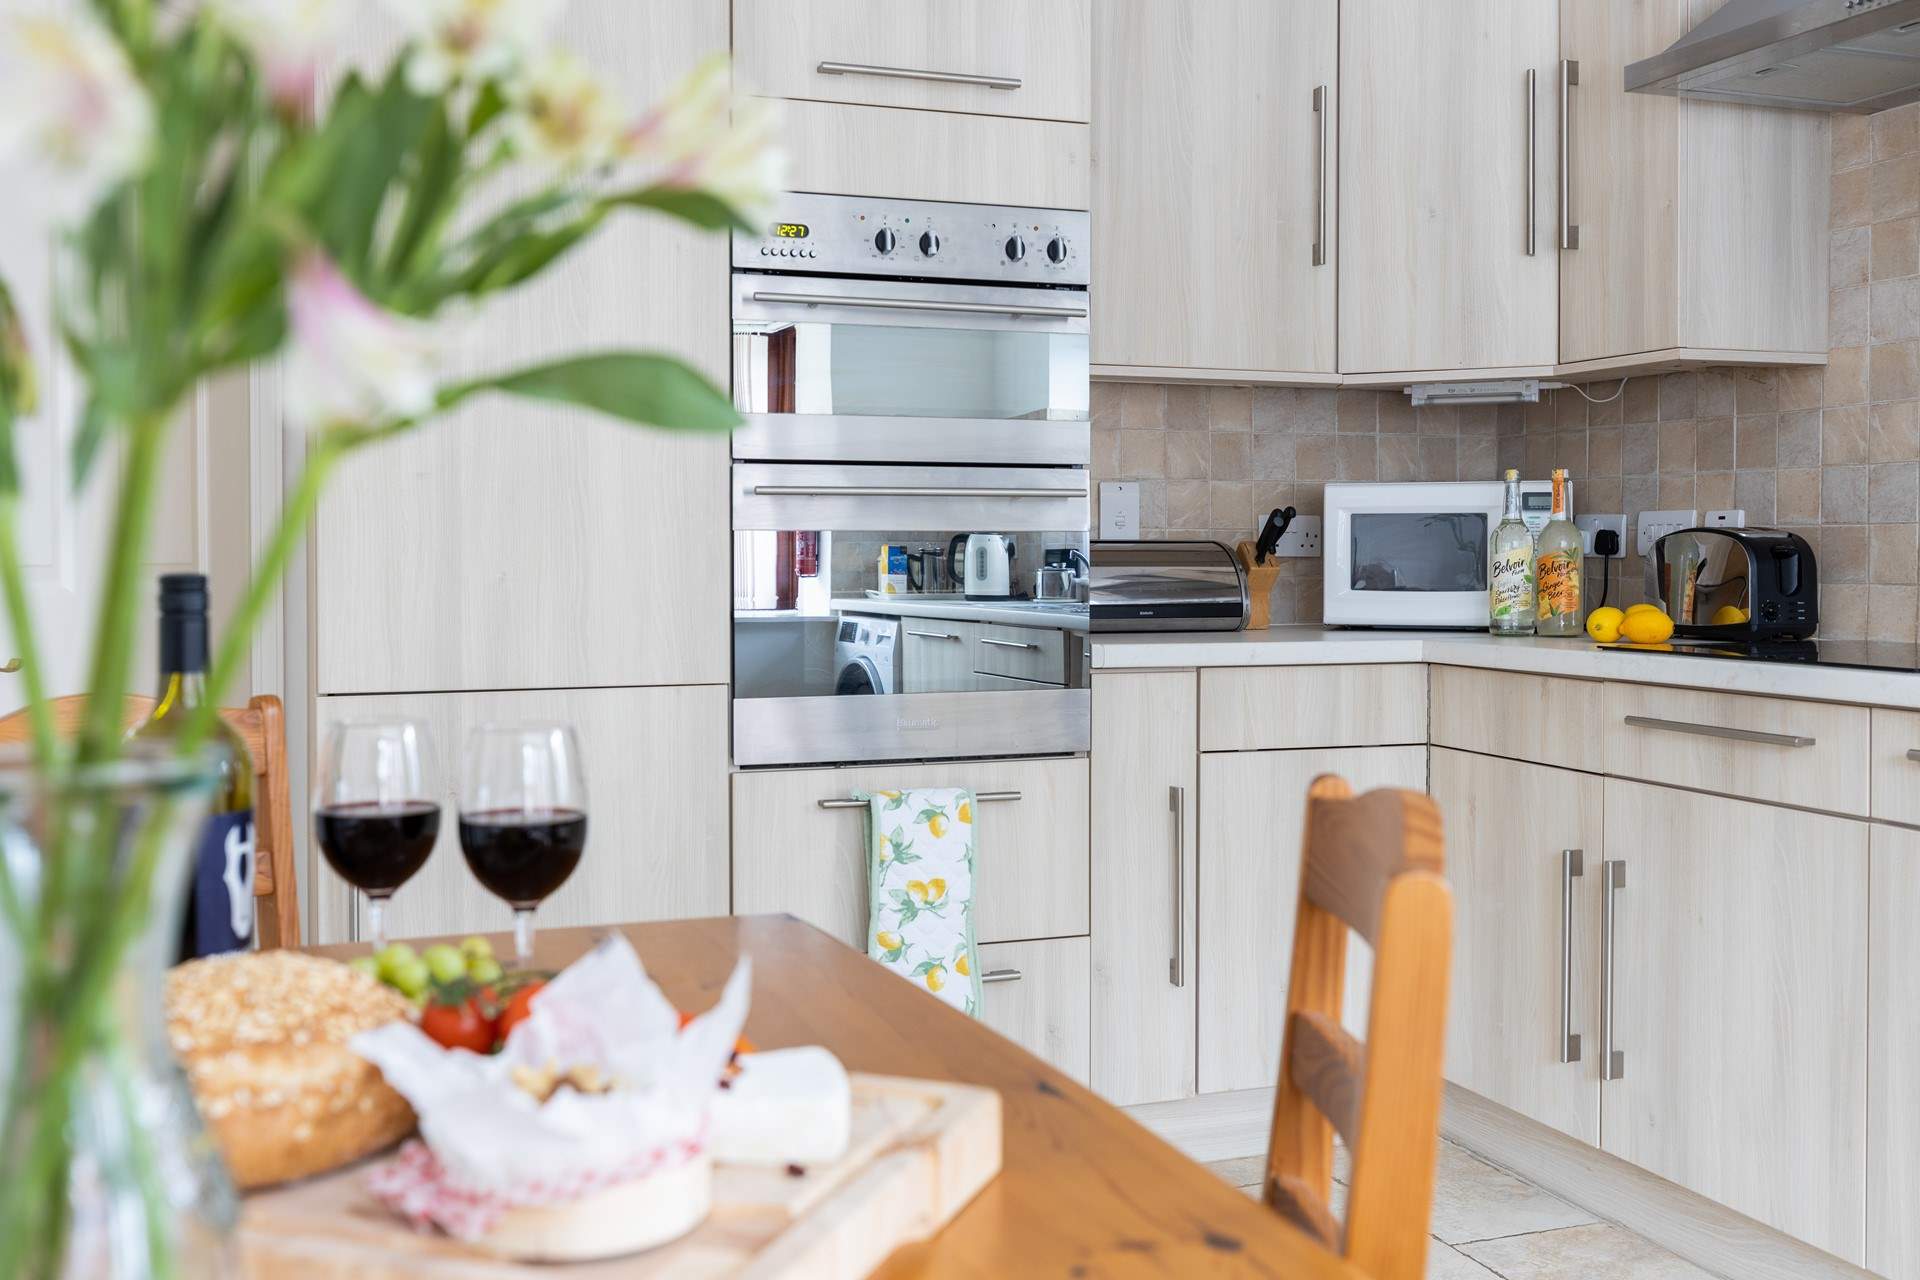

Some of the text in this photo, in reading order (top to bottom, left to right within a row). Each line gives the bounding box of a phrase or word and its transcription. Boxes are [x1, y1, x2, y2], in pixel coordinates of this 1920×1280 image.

[776, 225, 805, 237] 12:27
[1493, 558, 1525, 578] Belvoir
[1538, 560, 1570, 580] Belvoir
[1542, 581, 1563, 593] Ginger
[1547, 591, 1563, 601] Beer
